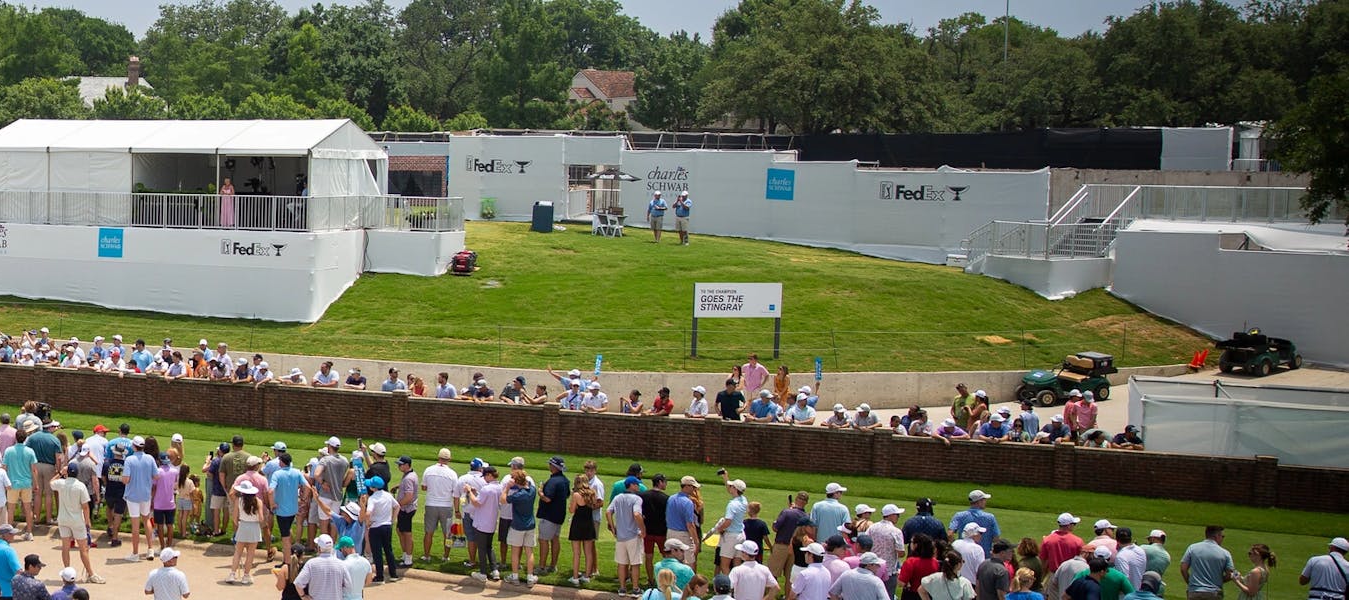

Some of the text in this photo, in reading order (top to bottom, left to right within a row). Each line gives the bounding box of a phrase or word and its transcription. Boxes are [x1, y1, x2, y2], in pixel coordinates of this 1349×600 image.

[474, 159, 512, 173] FedEx
[648, 167, 689, 180] charles
[647, 182, 689, 191] SCHWAB
[896, 185, 945, 201] FedEx
[233, 242, 270, 256] FedEx
[700, 303, 743, 311] STINGRAY
